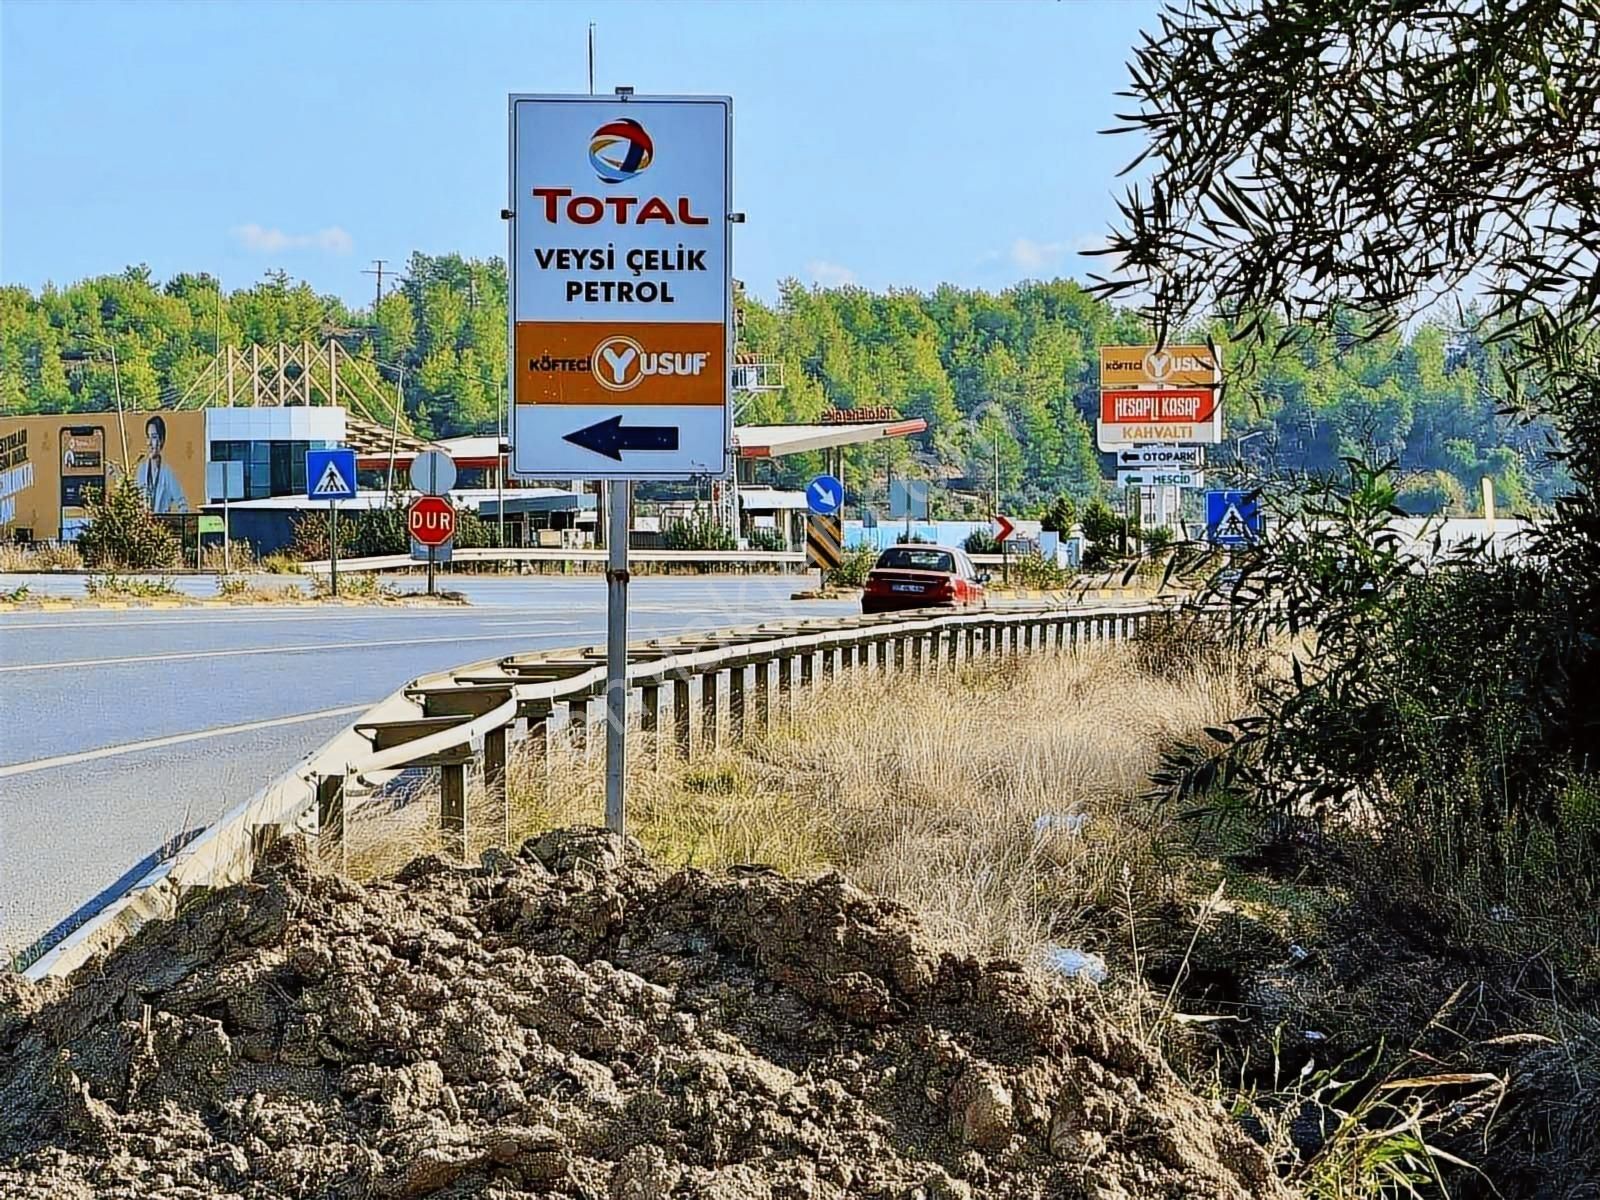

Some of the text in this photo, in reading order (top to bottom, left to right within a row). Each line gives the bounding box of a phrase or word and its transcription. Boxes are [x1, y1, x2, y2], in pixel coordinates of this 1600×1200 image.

[534, 242, 707, 277] VEYSİ ÇELİK
[566, 280, 675, 303] PETROL
[529, 355, 592, 372] KÖFTECİ
[1115, 397, 1201, 421] HESAPLI KASAP
[1122, 426, 1193, 439] KAHVALTI
[1142, 452, 1195, 462] OTOPARK
[1152, 472, 1191, 484] MESCİD
[412, 512, 450, 530] DUR
